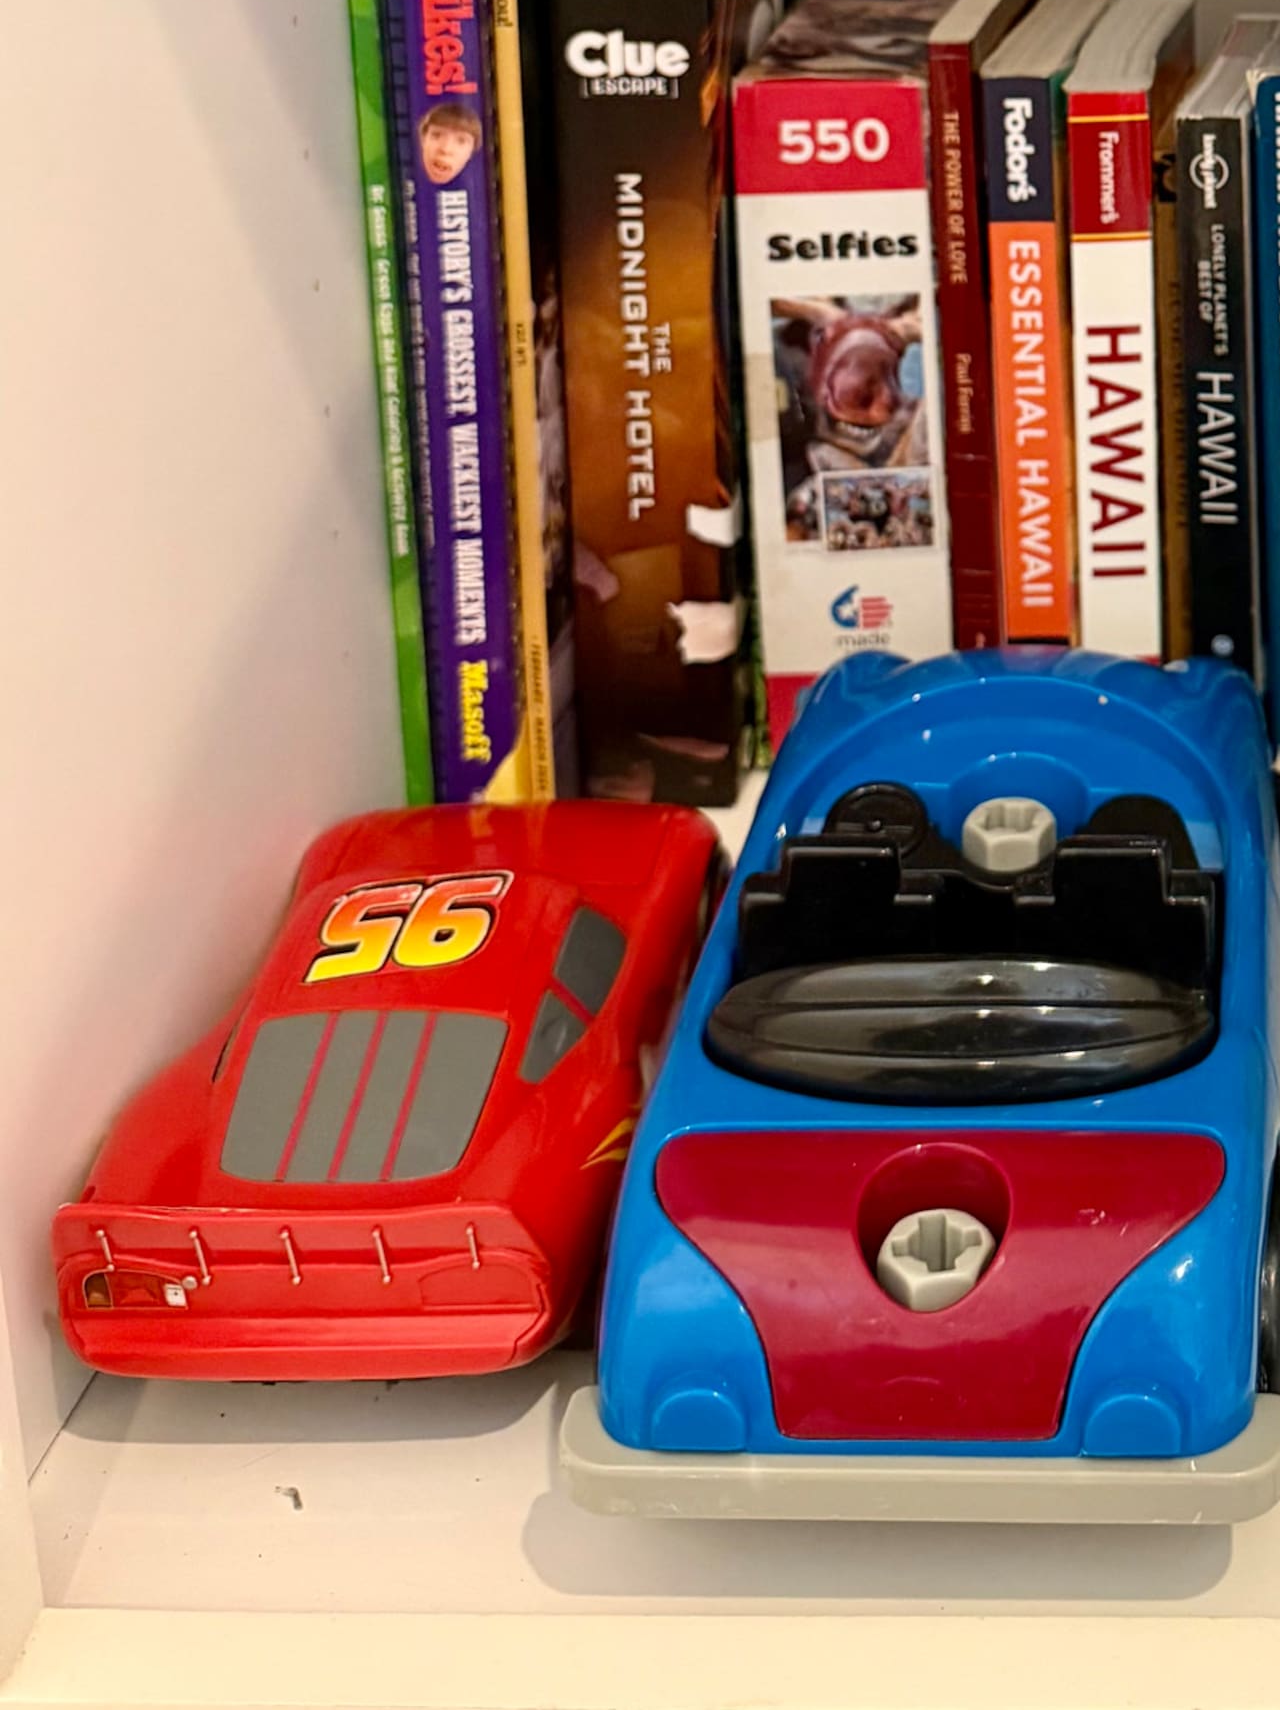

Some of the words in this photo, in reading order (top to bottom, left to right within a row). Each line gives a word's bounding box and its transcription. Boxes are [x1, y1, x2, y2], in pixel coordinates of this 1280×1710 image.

[565, 29, 690, 78] Clue
[592, 79, 668, 96] ESCAPE
[778, 118, 890, 164] 550
[945, 149, 964, 211] POWER
[1003, 97, 1037, 203] Fodor's
[1097, 130, 1120, 225] Frommer's
[436, 191, 474, 304] HISTORY'S
[615, 173, 650, 377] MIDNIGHT
[768, 231, 918, 261] Selfies
[951, 240, 968, 284] LOVE
[1211, 224, 1226, 277] LONELY
[651, 323, 672, 374] THE
[955, 354, 972, 386] Paul
[1008, 241, 1048, 447] ESSENTIAL
[448, 422, 482, 534] WACKIEST
[625, 390, 655, 520] HOTEL
[1087, 325, 1146, 577] HAWAII
[1196, 372, 1239, 525] HAWAII
[1017, 459, 1054, 607] HAWAII
[454, 539, 487, 644] MOMENTS
[458, 660, 491, 763] Masoff
